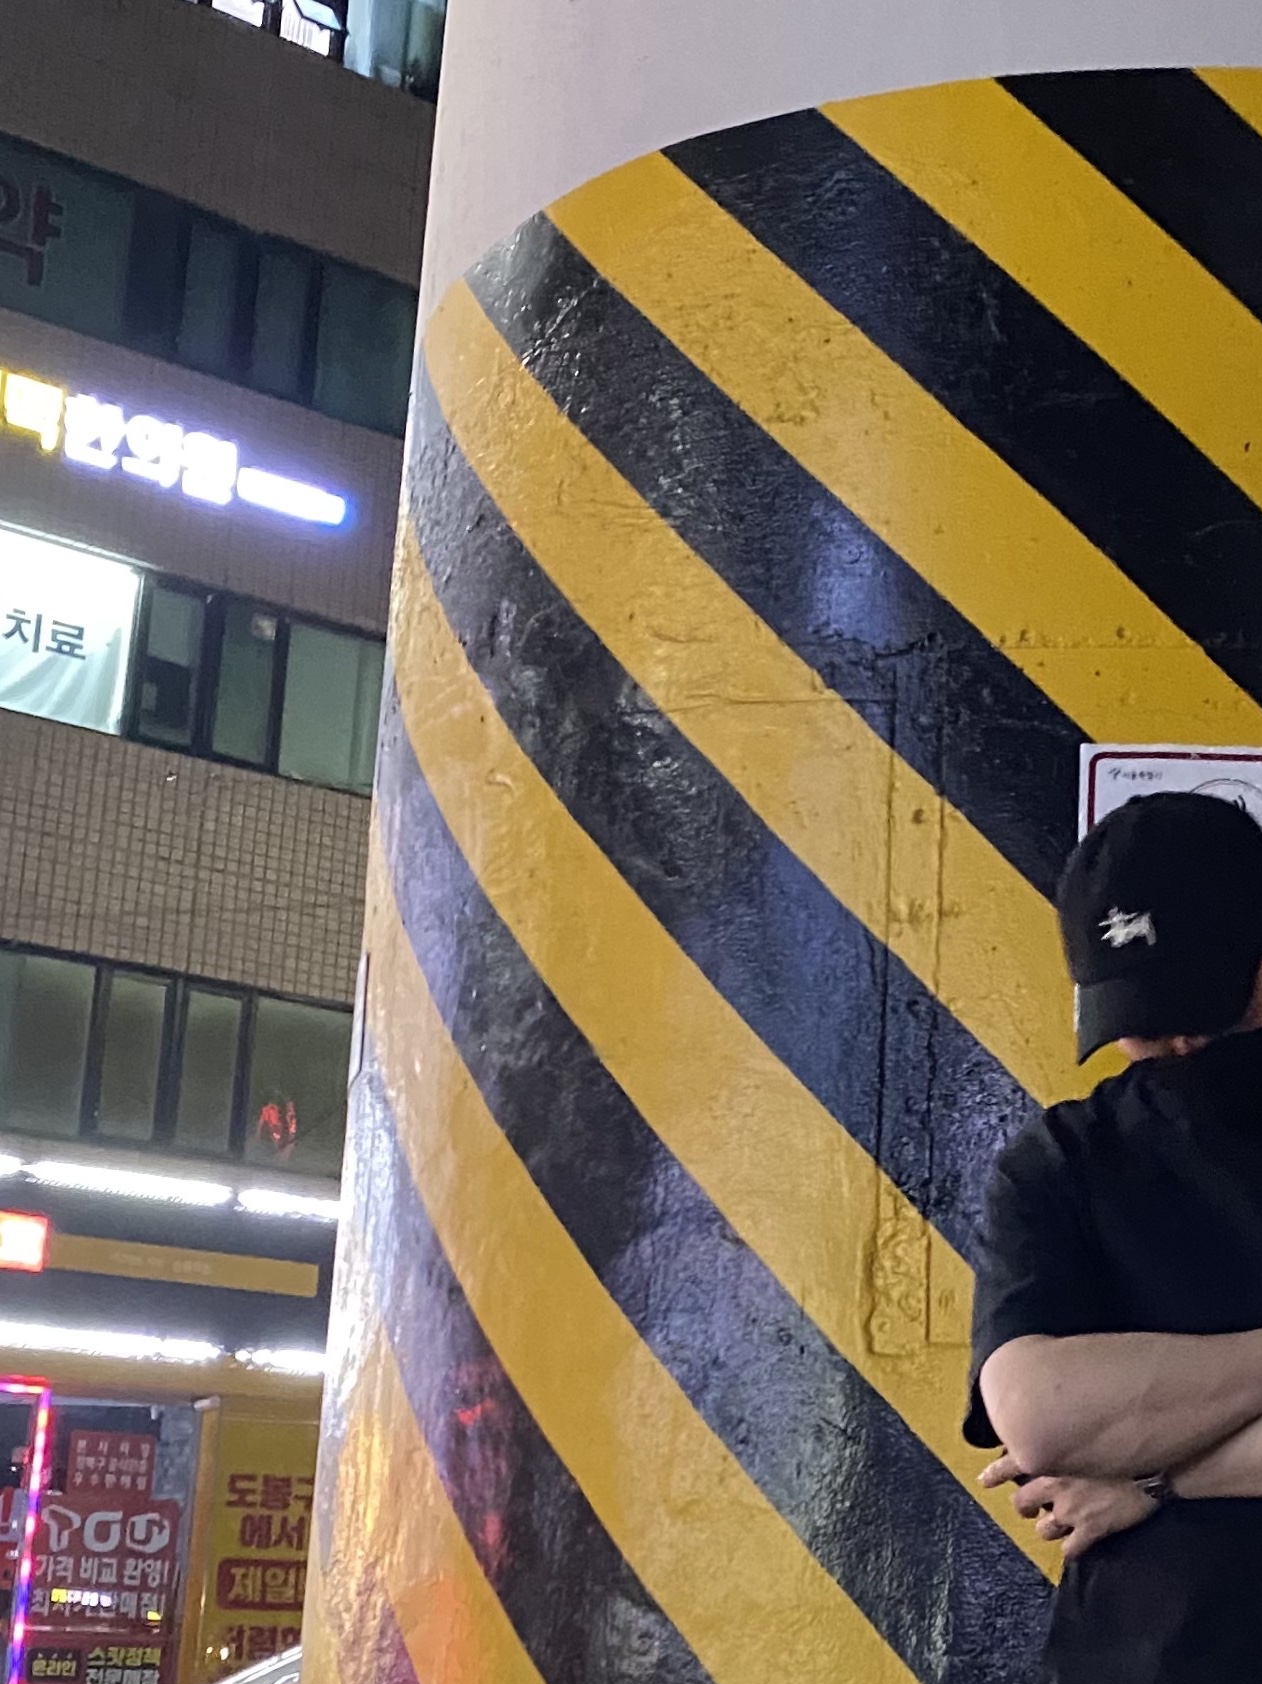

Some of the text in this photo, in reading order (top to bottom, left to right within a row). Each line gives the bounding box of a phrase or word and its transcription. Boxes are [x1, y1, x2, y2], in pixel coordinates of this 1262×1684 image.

[2, 608, 87, 660] 치료
[239, 1514, 306, 1550] 에서
[35, 1556, 74, 1584] 가격
[80, 1556, 118, 1585] 비교
[32, 1658, 77, 1677] 온라인
